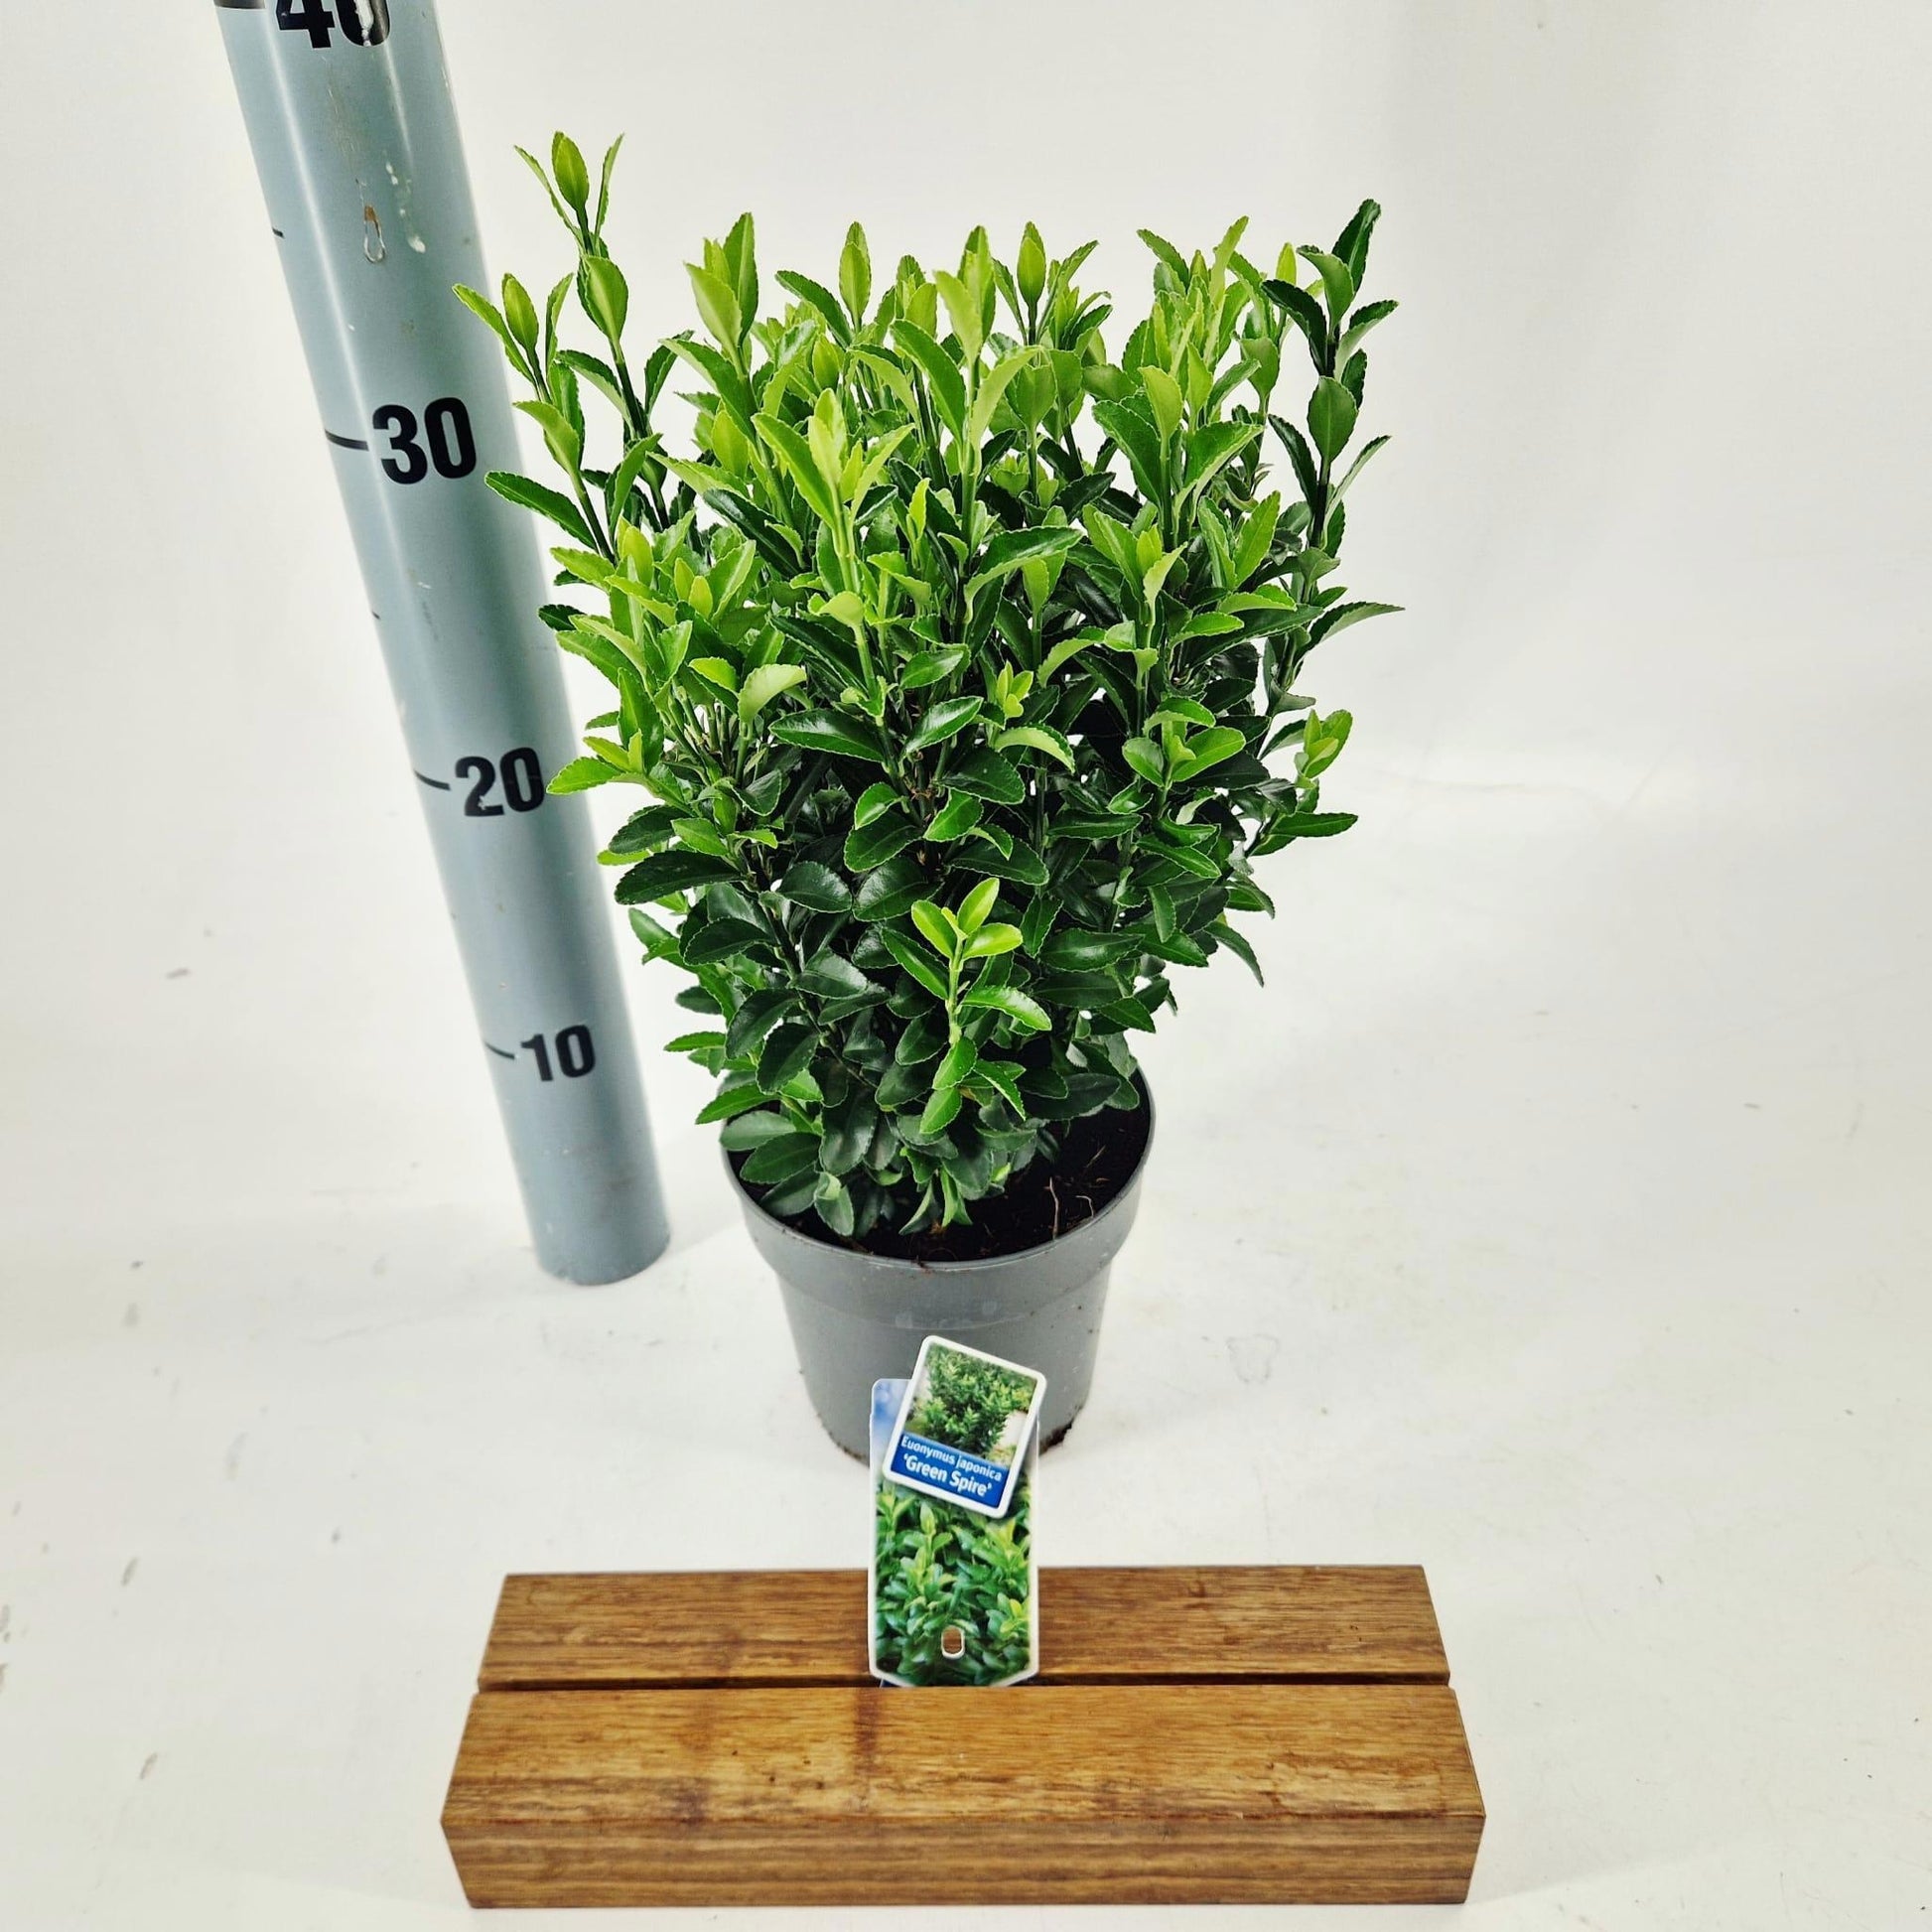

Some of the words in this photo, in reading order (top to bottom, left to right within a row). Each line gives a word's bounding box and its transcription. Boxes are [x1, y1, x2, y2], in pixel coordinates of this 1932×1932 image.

[372, 397, 477, 484] 30
[455, 748, 545, 817] 20
[520, 1025, 596, 1082] 10
[900, 1436, 955, 1465] Euonymus
[956, 1455, 1002, 1481] japonica
